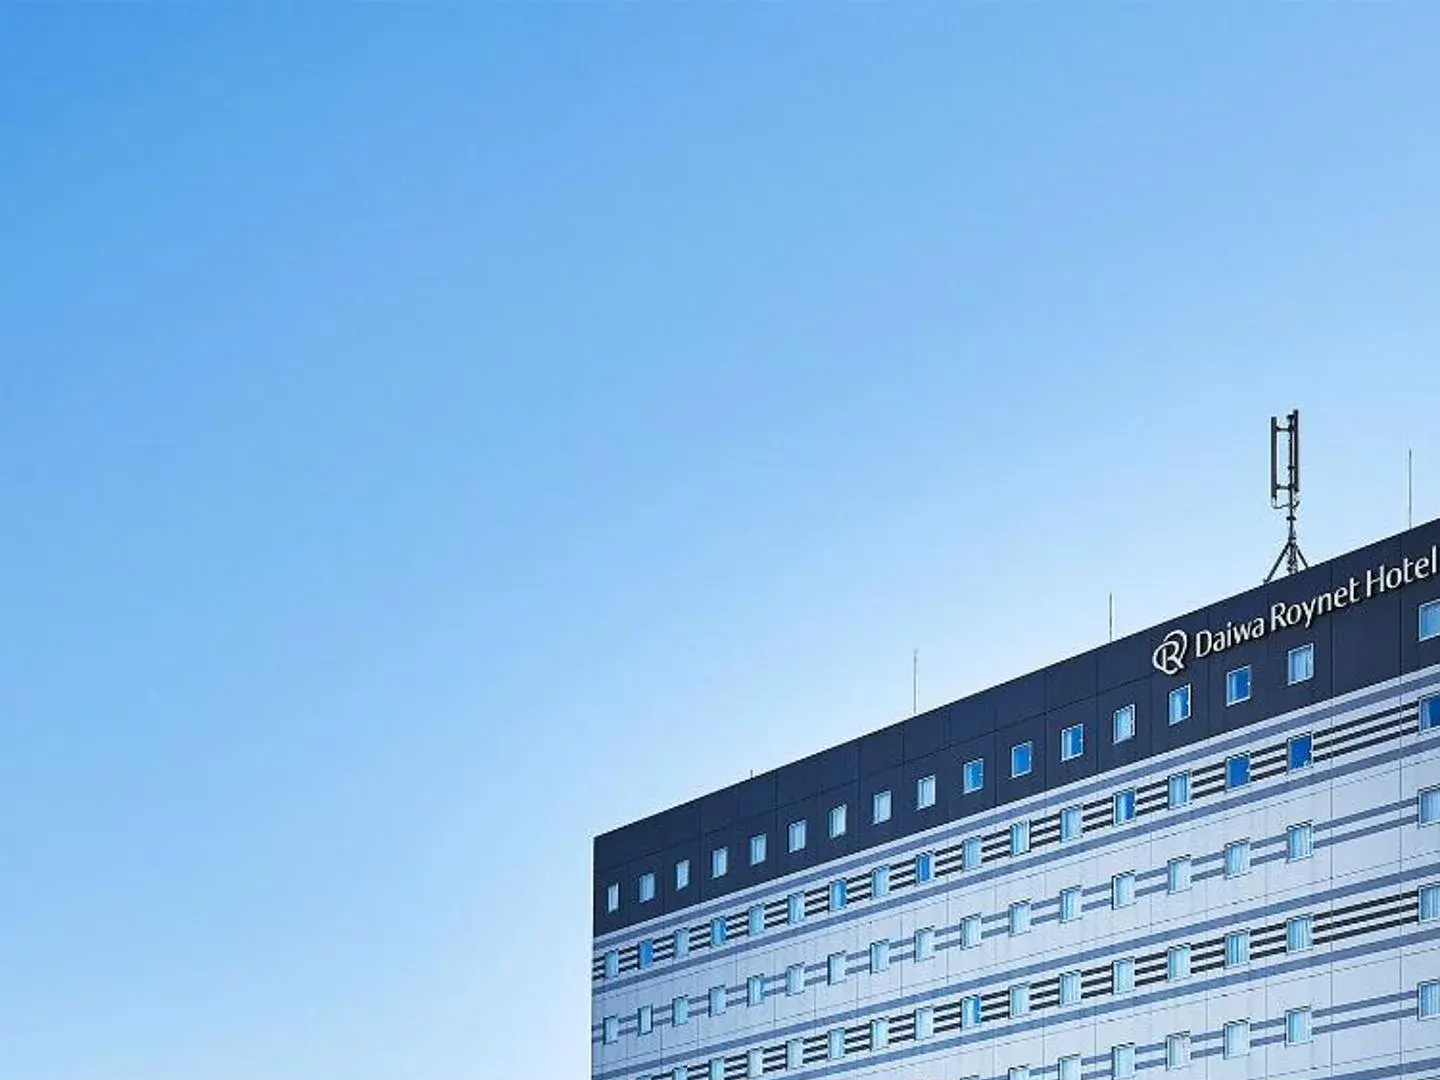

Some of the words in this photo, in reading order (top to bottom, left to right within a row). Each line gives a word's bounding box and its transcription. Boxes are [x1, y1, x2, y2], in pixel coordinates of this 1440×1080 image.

[1195, 616, 1265, 658] Daiwa
[1270, 576, 1361, 628] Roynet
[1365, 544, 1438, 598] Hotel
